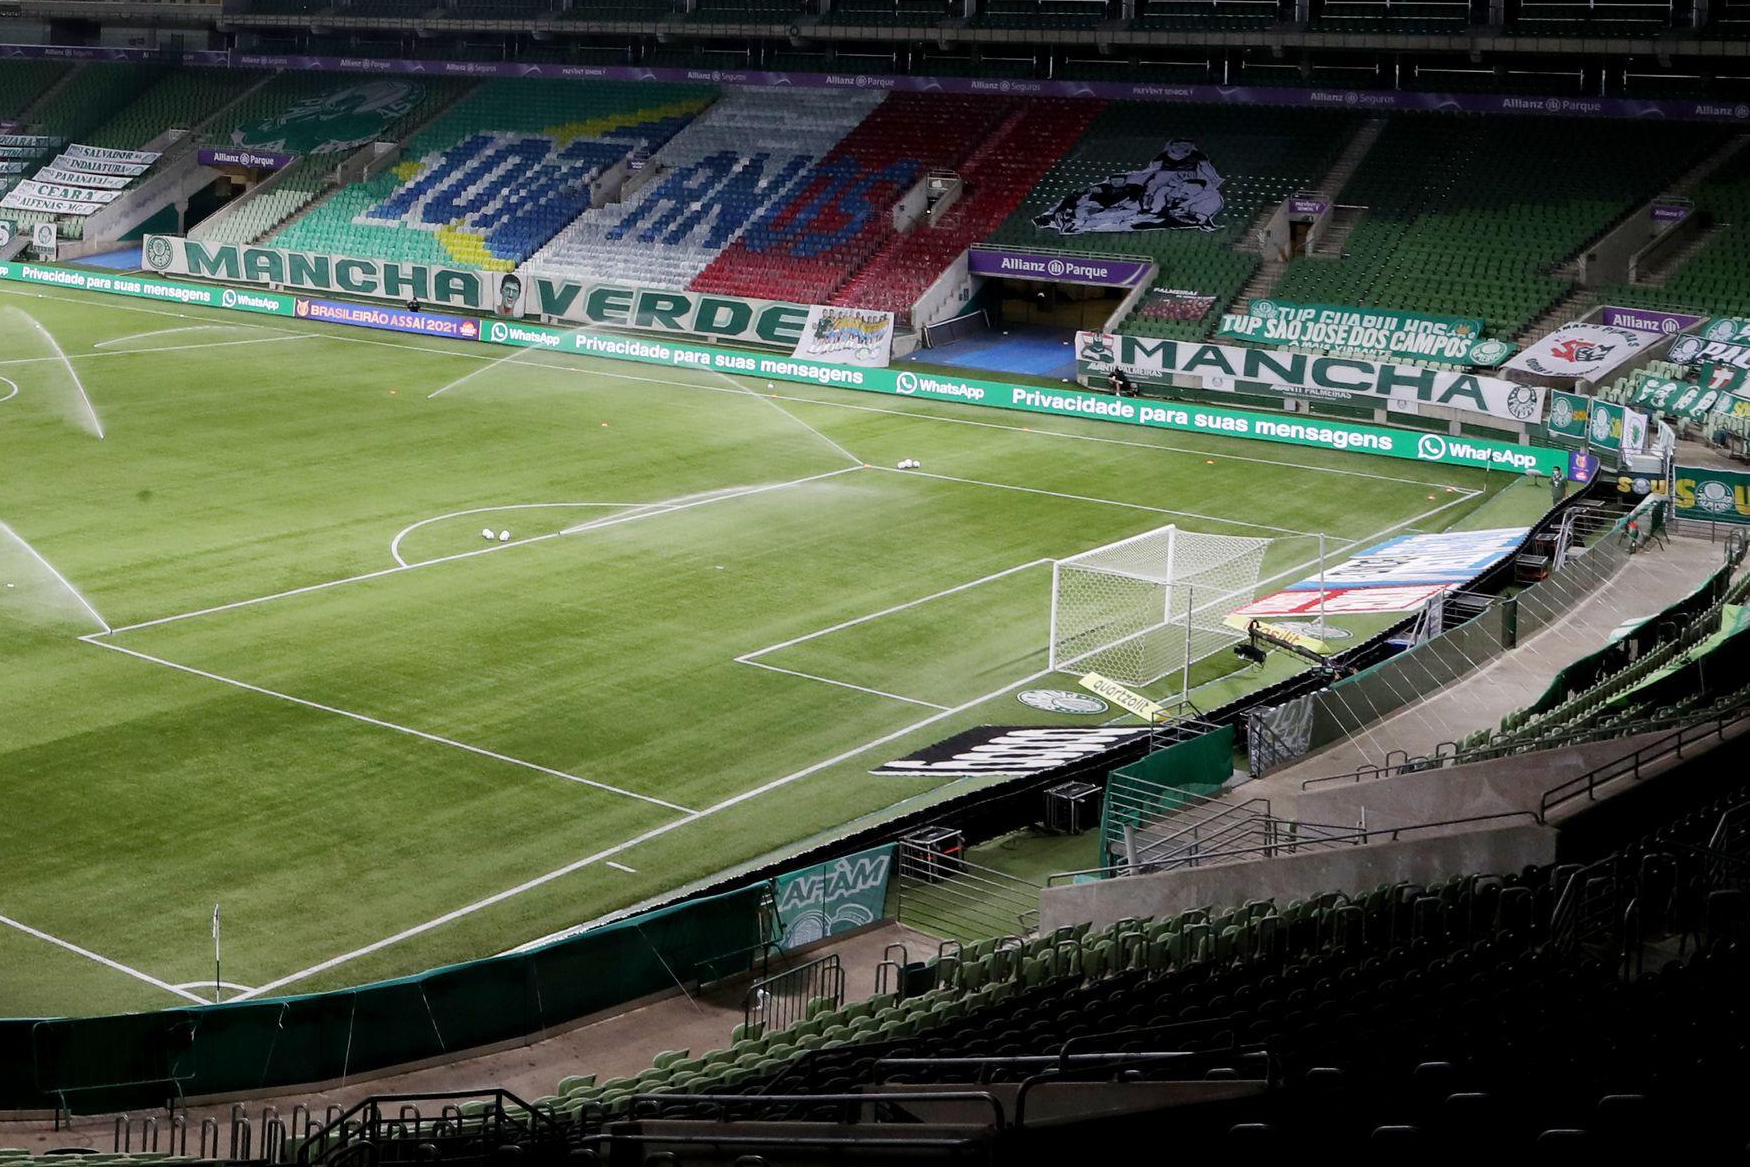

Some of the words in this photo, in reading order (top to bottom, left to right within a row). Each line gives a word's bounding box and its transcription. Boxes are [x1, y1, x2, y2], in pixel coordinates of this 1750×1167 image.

[688, 71, 710, 80] Allianz
[826, 76, 855, 85] Allianz
[867, 77, 894, 88] Parque
[971, 81, 999, 90] Allianz
[1011, 82, 1041, 92] Seguros
[1310, 92, 1344, 102] Allianz
[1359, 93, 1394, 104] Seguros
[1503, 98, 1543, 110] Allianz
[1562, 100, 1602, 112] Parque
[1695, 105, 1732, 116] Allianz
[82, 147, 134, 160] SALVADOR
[214, 152, 239, 162] Allianz
[250, 155, 274, 166] Parque
[183, 241, 480, 309] MANCHA
[1001, 257, 1046, 272] Allianz
[1065, 263, 1108, 280] Parque
[22, 266, 85, 286] Privacidade
[87, 275, 111, 290] para
[114, 280, 141, 293] suas
[143, 284, 211, 302] mensagens
[237, 294, 280, 312] WhatsApp
[536, 278, 812, 345] VERDE
[310, 305, 388, 326] BRASILEIRÃO
[427, 319, 458, 334] 2021
[1613, 314, 1659, 332] Allianz
[1350, 326, 1390, 349] DOS
[1391, 330, 1474, 359] CAMPOS
[509, 328, 560, 346] WhatsApp
[575, 335, 670, 360] Privacidade
[674, 348, 711, 369] para
[714, 353, 756, 371] suas
[760, 359, 864, 384] mensagens
[1121, 336, 1490, 411] MANCHA
[919, 378, 986, 401] WhatsApp
[1012, 388, 1135, 419] Privacidade
[1139, 407, 1188, 425] para
[1194, 413, 1249, 433] suas
[1255, 419, 1394, 451] mensagens
[1448, 443, 1537, 469] WhatsApp
[1093, 680, 1149, 714] quartzolit
